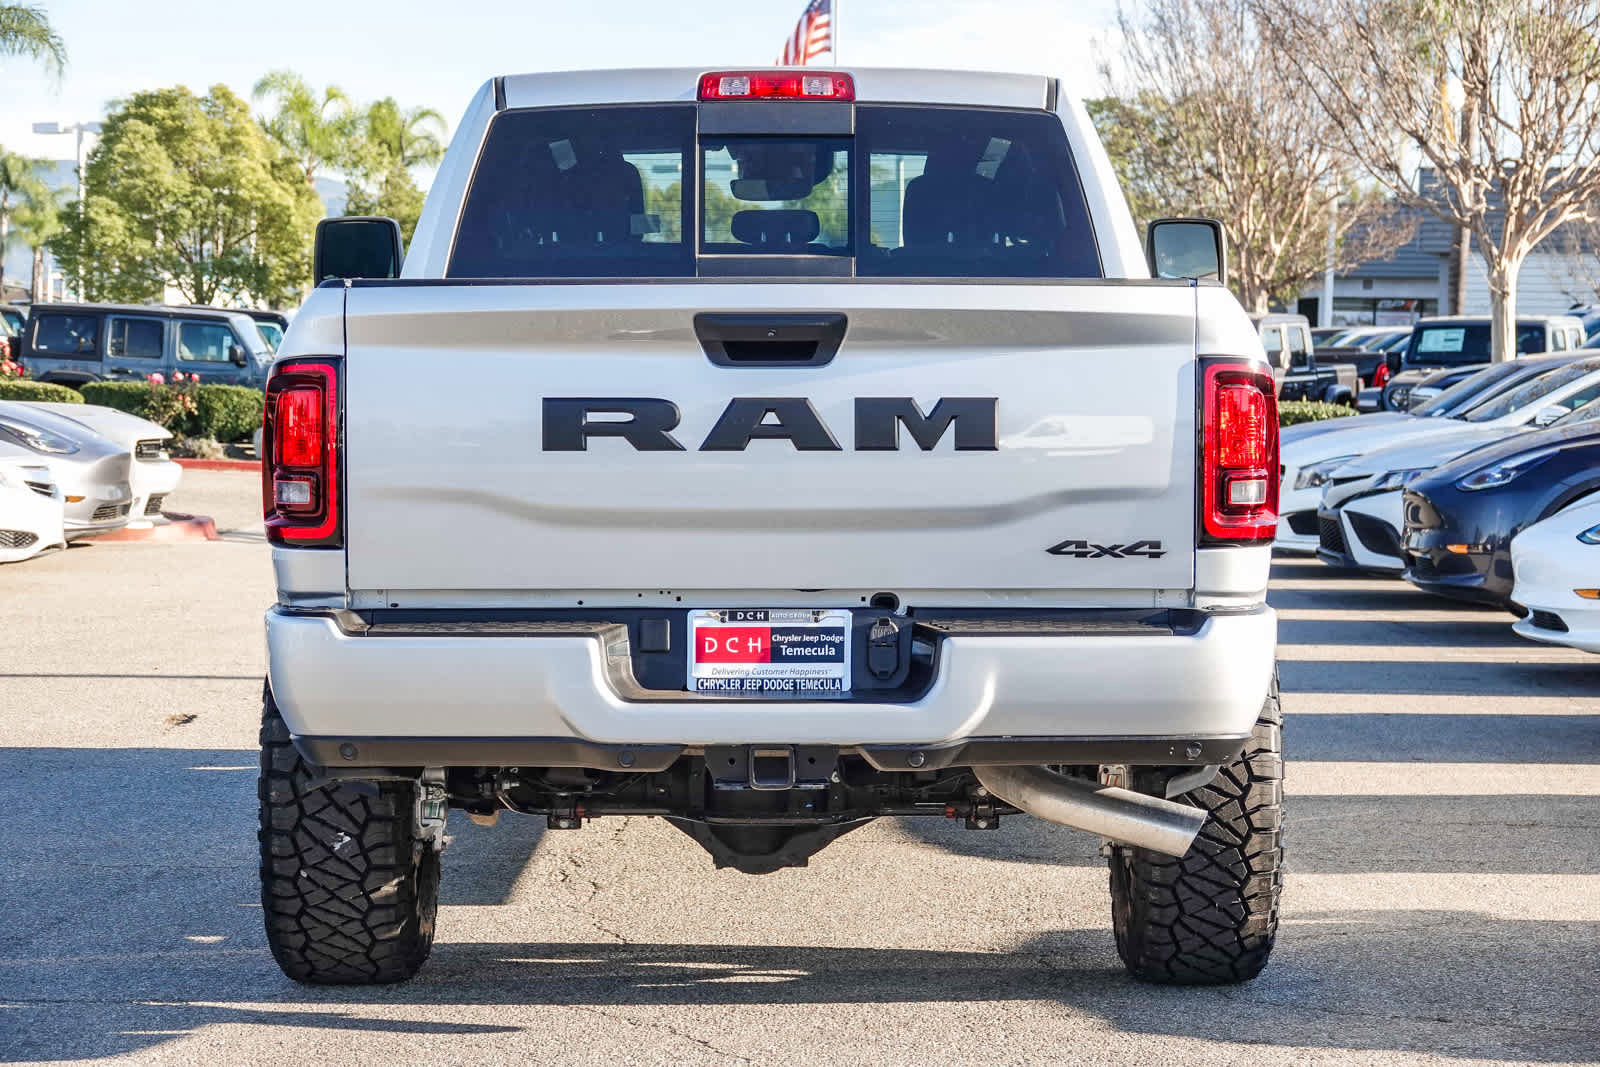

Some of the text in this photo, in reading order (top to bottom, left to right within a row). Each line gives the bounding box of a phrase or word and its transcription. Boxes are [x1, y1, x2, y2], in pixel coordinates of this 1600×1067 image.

[542, 397, 1000, 451] RAM
[737, 612, 764, 620] DCH
[772, 634, 844, 643] Chrysler Jeep Dodge
[705, 637, 761, 653] DCH
[780, 645, 836, 656] Temecula
[712, 668, 750, 676] Delivering
[698, 679, 841, 690] CHRYSLER JEEP DODGE TEMECULA
